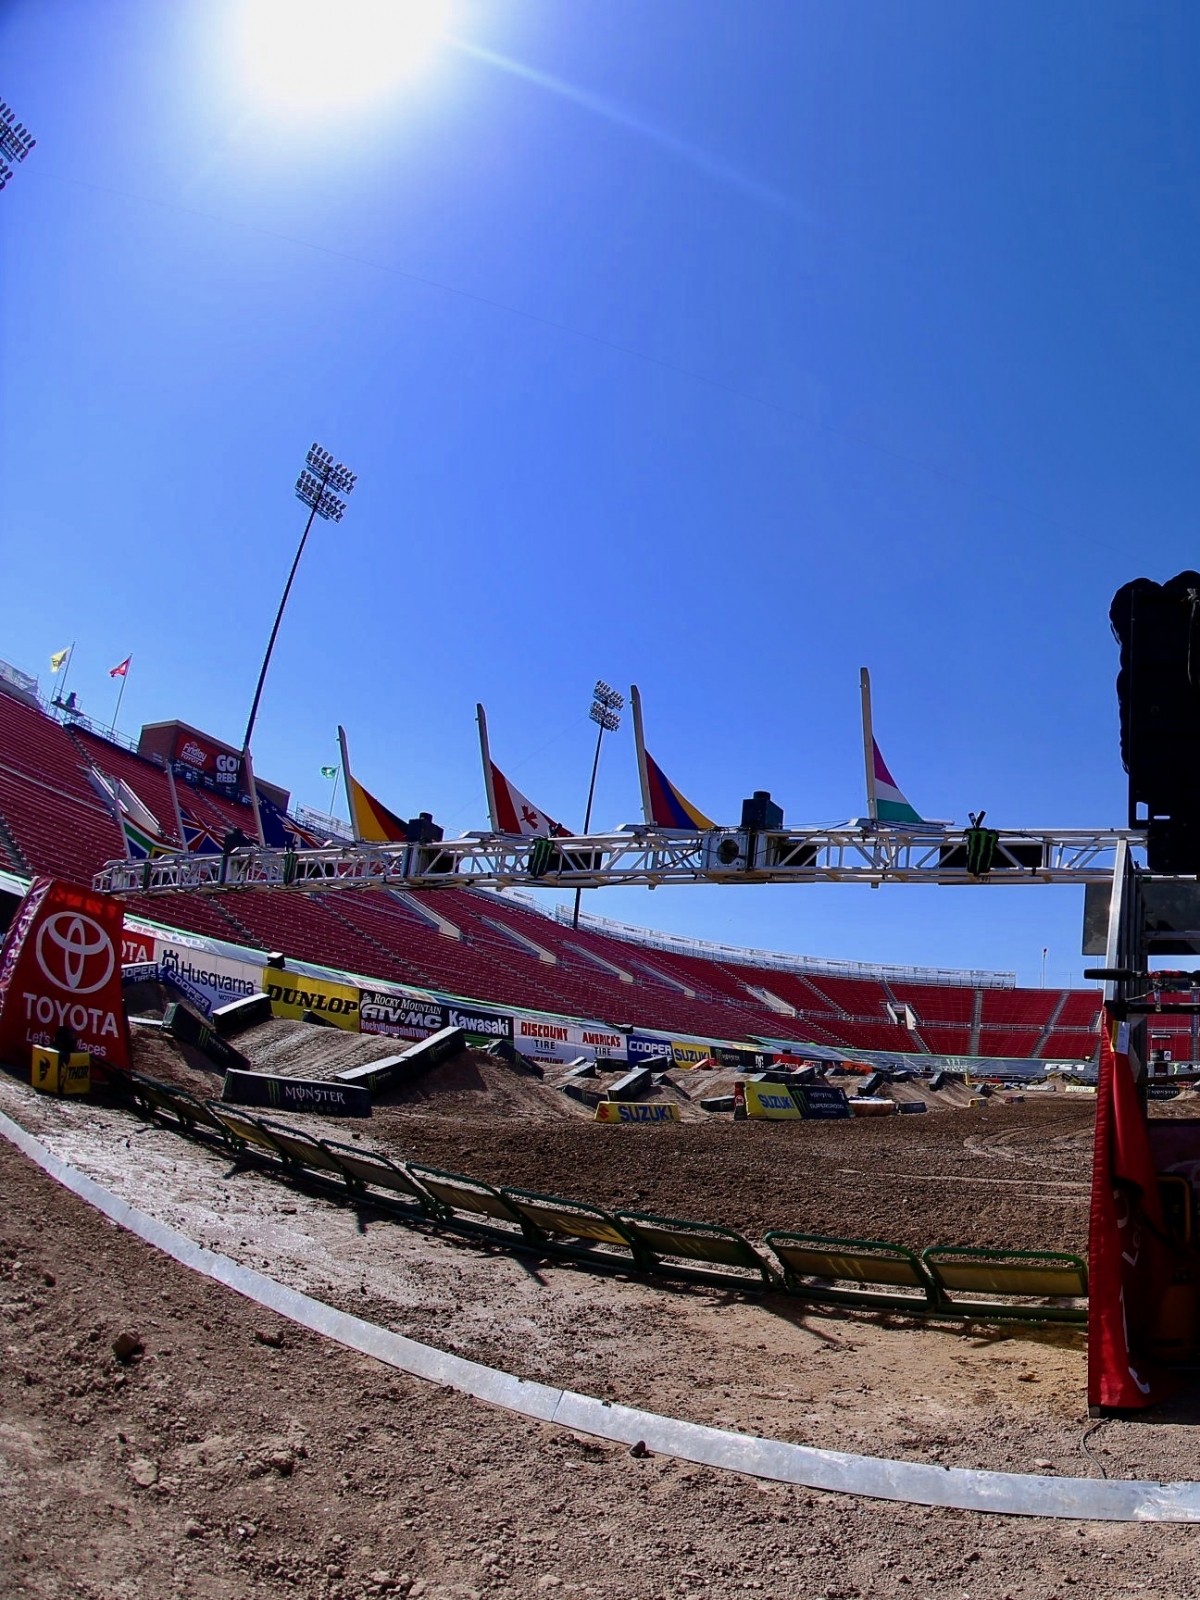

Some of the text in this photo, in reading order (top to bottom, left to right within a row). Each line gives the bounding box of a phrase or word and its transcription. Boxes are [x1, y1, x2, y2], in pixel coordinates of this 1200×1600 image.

[182, 742, 207, 762] Findlay
[216, 773, 237, 784] REBS
[181, 961, 255, 995] Husqvarna
[168, 969, 210, 1009] COOPER
[267, 984, 358, 1015] DUNLOP
[374, 993, 442, 1015] ROCKY MOUNTAIN
[23, 992, 119, 1038] TOYOTA
[449, 1010, 509, 1036] Kawasaki
[521, 1022, 568, 1041] DISCOUNT
[583, 1032, 620, 1047] AMERICA'S
[76, 1039, 107, 1056] laces
[534, 1040, 556, 1049] TIRE
[594, 1047, 611, 1056] TIRE
[629, 1041, 672, 1055] COOPER
[673, 1049, 709, 1062] SUZUKI
[285, 1085, 346, 1104] MONSTER
[757, 1094, 796, 1110] SUZUKI
[618, 1104, 674, 1120] SUZUKI
